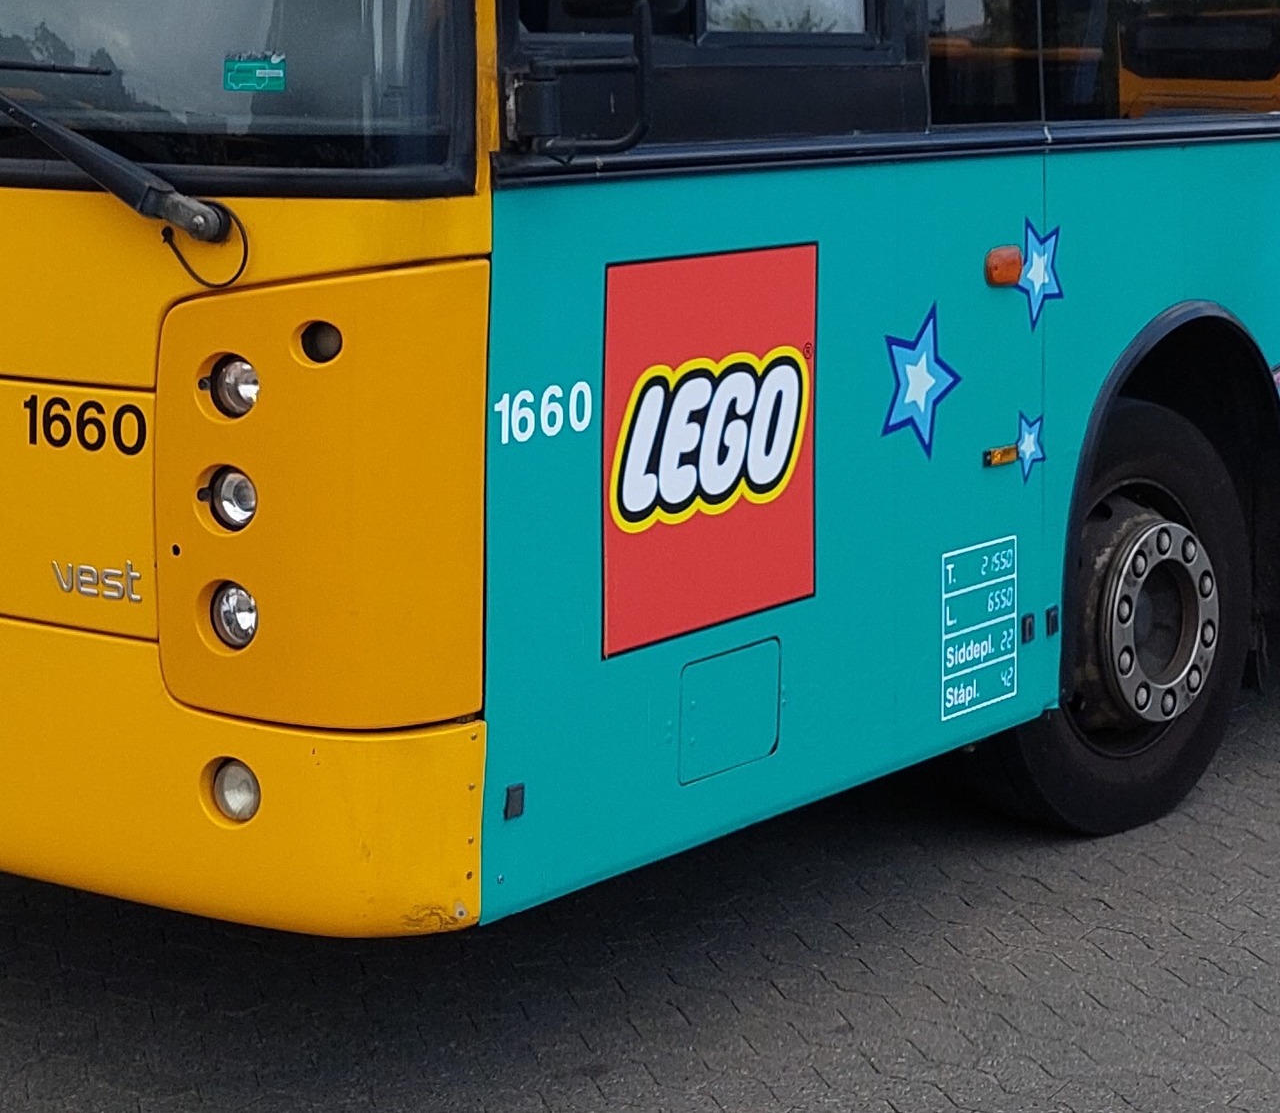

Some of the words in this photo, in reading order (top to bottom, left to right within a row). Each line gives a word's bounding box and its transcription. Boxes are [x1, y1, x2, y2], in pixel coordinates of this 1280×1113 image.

[23, 394, 148, 456] 1660
[493, 381, 592, 445] 1660
[618, 357, 803, 519] LEGO
[51, 559, 143, 603] vest
[945, 563, 957, 585] T.
[945, 605, 957, 627] L.
[987, 586, 1014, 613] 6550
[946, 634, 995, 668] Siddepl.
[1000, 628, 1014, 652] 22
